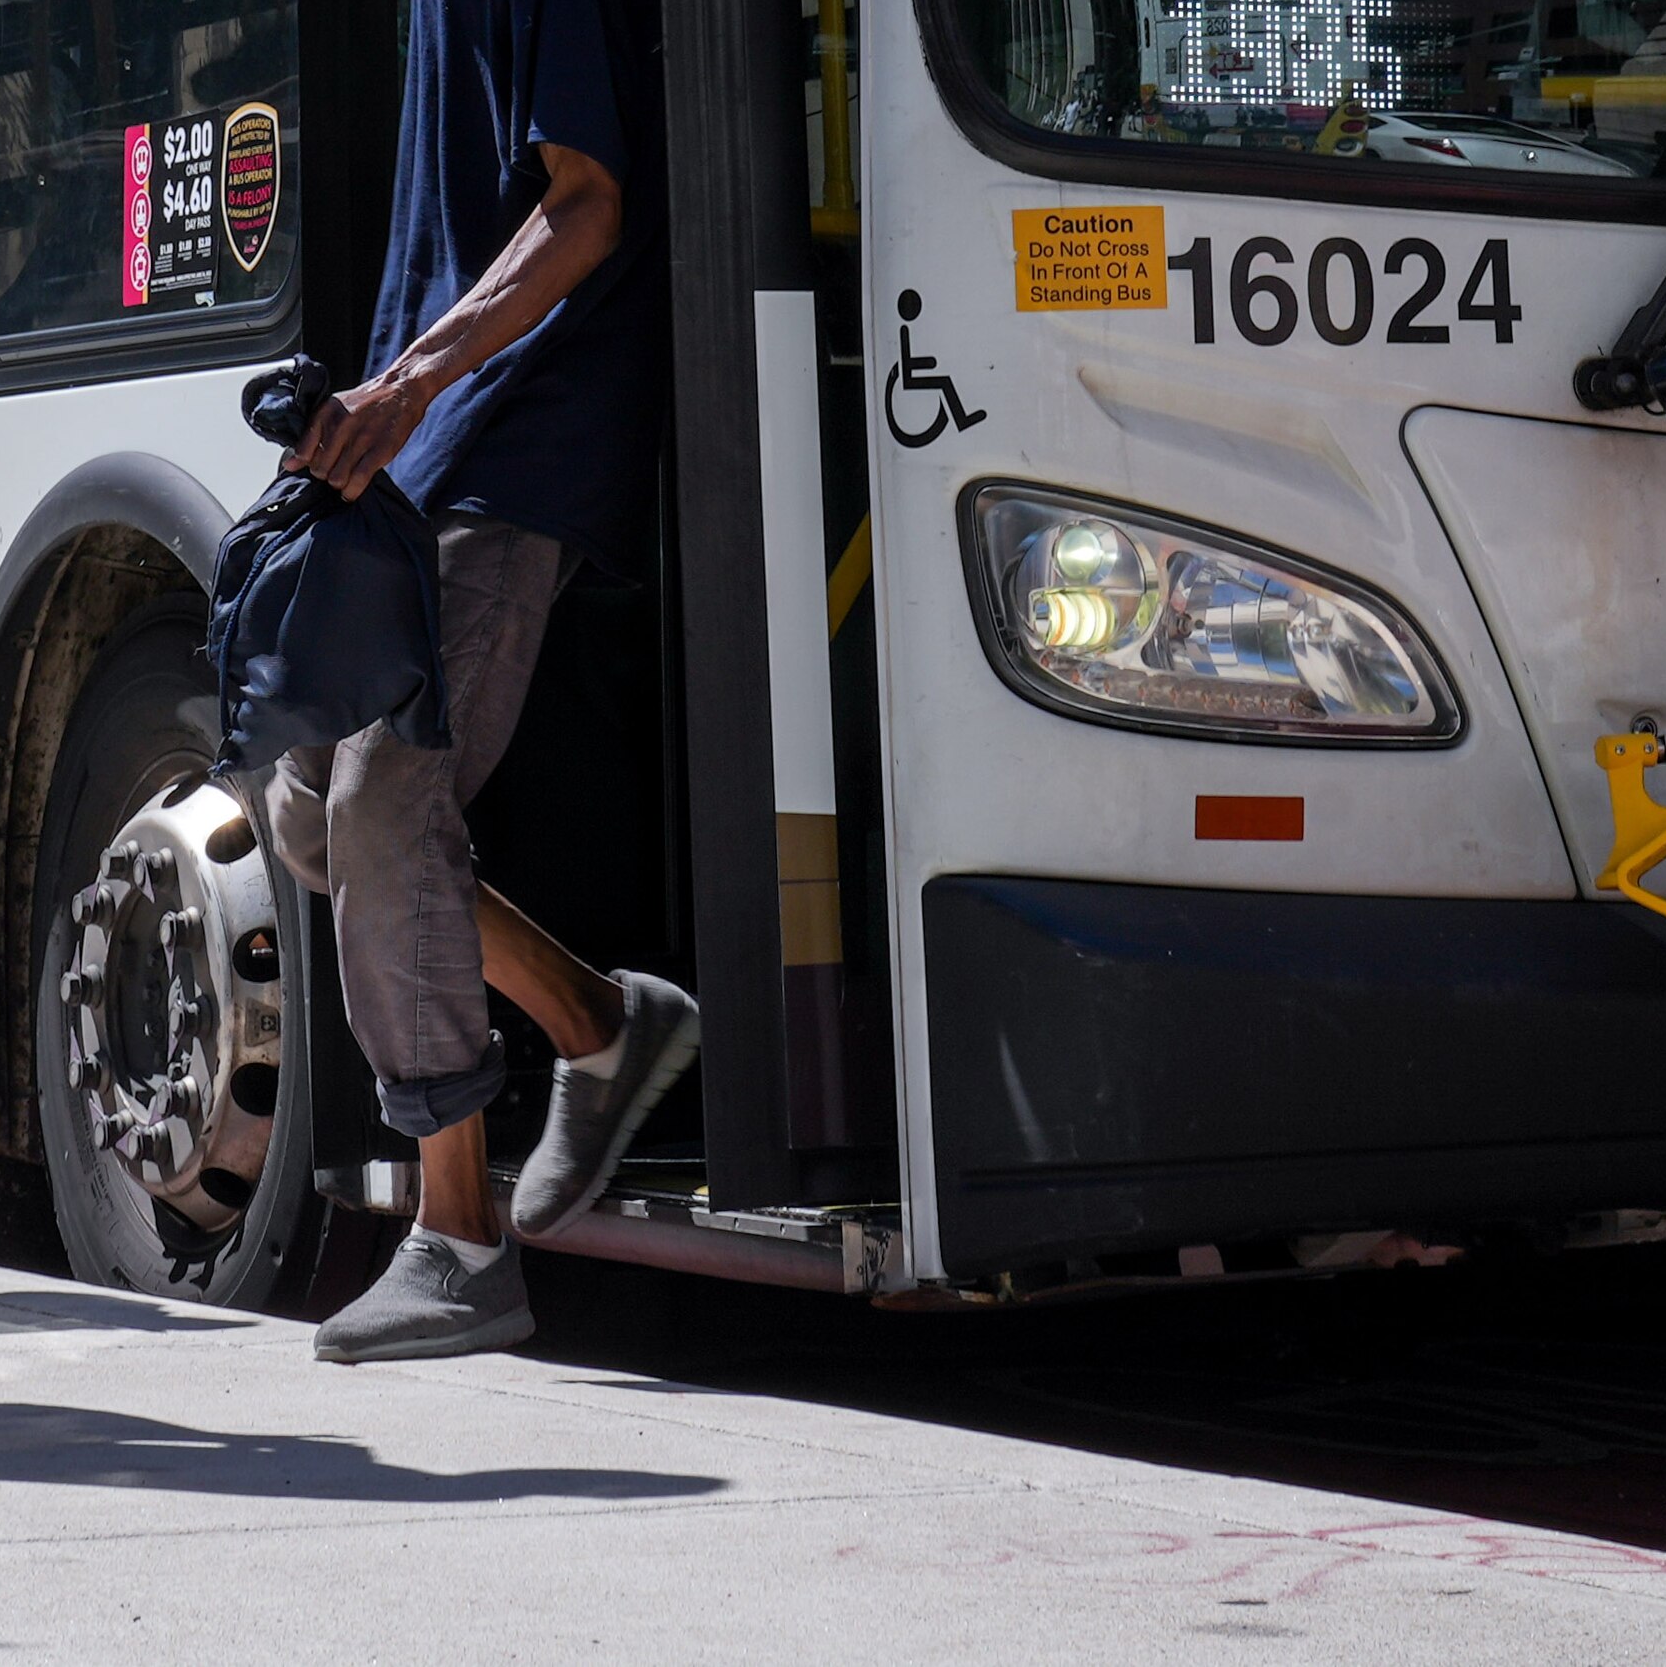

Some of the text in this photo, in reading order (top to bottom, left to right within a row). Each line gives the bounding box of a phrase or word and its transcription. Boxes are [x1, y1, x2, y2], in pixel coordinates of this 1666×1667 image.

[242, 118, 272, 132] OPERATORS
[164, 120, 213, 169] $2.00
[185, 159, 212, 177] ONE WAY
[228, 153, 273, 174] ASSAULTING
[228, 167, 273, 186] A BUS OPERATOR
[163, 175, 213, 224] $4.60
[228, 185, 273, 206] IS A FELONY
[185, 214, 211, 232] DAY PASS
[1044, 214, 1133, 234] Caution
[1029, 240, 1150, 258] Do Not Cross
[1031, 262, 1148, 280] In Front Of A
[1030, 285, 1151, 305] Standing Bus
[1167, 235, 1522, 346] 16024
